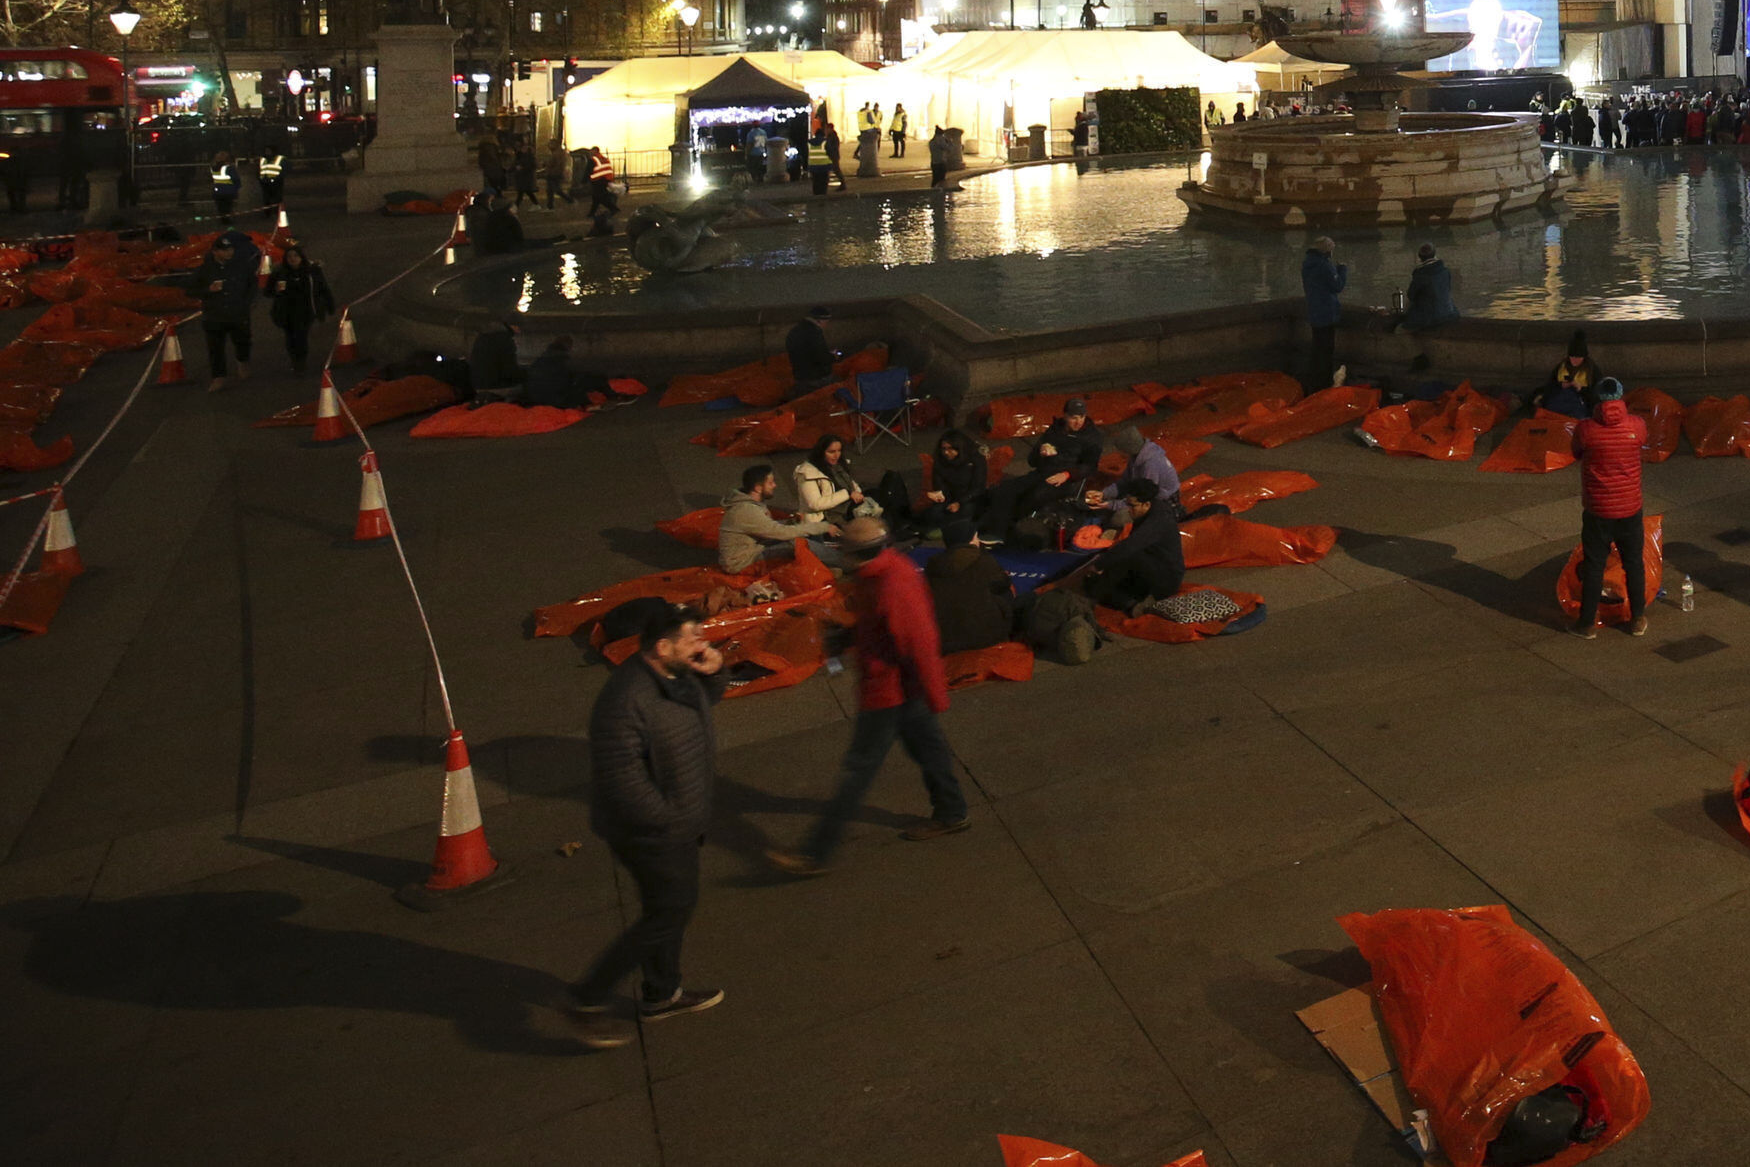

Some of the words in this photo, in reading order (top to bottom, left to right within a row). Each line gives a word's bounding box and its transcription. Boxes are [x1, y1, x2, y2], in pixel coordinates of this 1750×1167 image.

[1632, 84, 1650, 94] THE
[1288, 97, 1306, 106] THE
[1279, 105, 1320, 115] WOLD'S
